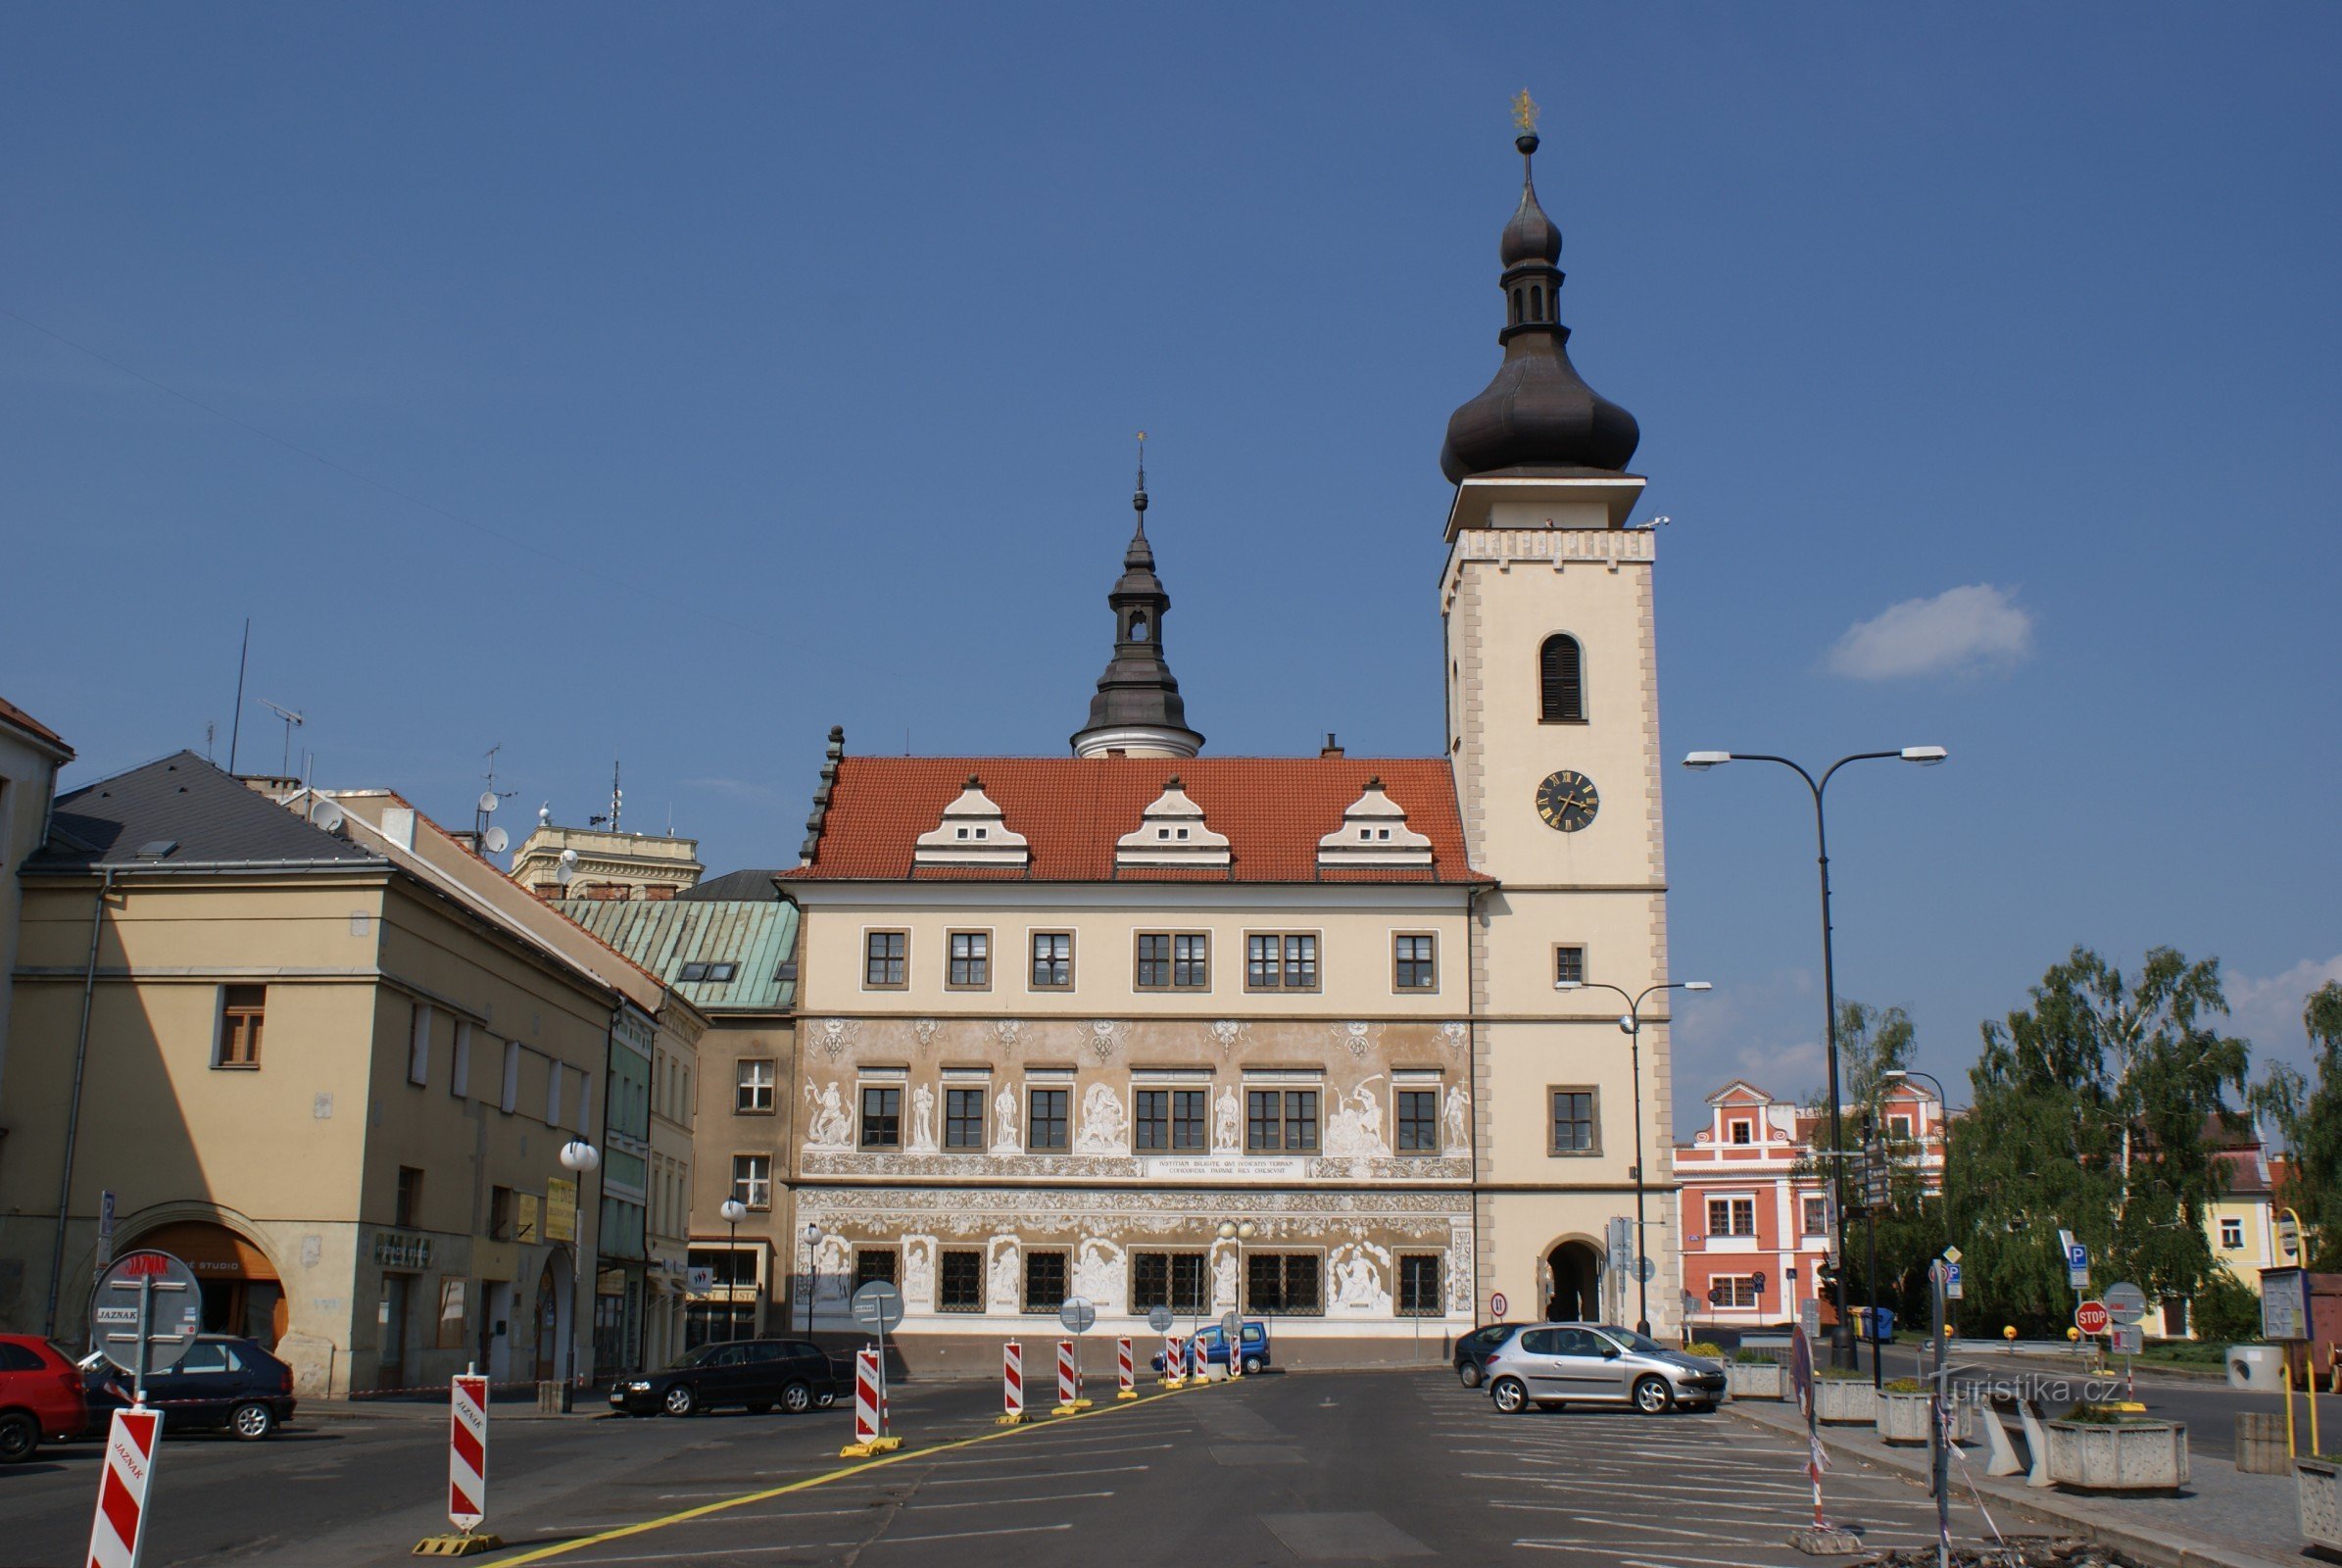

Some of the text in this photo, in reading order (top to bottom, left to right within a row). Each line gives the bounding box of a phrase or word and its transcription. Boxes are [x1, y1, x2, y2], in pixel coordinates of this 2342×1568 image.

[2073, 1248, 2083, 1262] P
[199, 1261, 239, 1270] STUDIO
[1950, 1266, 1959, 1278] P
[98, 1311, 137, 1320] JAZNAK
[2079, 1311, 2106, 1324] STOP
[457, 1400, 484, 1429] JAZNAK
[115, 1443, 144, 1480] JAZNAK
